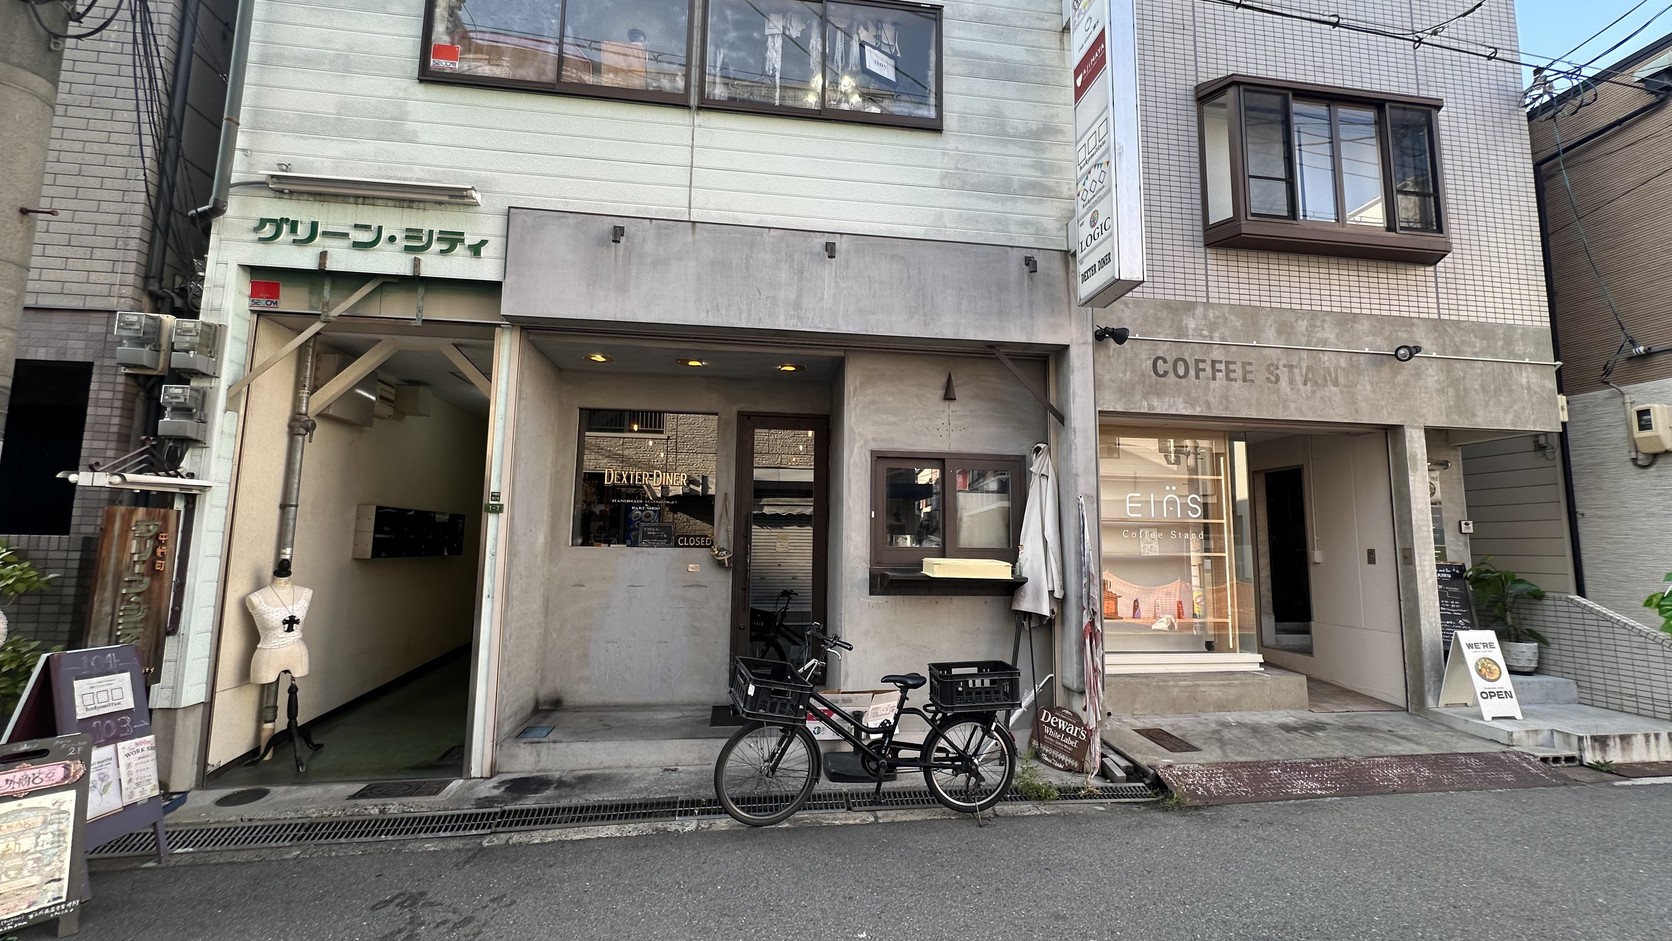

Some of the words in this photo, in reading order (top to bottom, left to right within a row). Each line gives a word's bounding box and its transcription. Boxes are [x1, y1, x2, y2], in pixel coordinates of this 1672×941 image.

[253, 216, 489, 257] グリーン・シティ
[1080, 217, 1111, 254] LOGIC
[1081, 263, 1097, 284] DEXTER
[1097, 252, 1112, 272] DINER
[1151, 355, 1255, 384] COFFEE
[653, 469, 688, 487] DINER
[677, 536, 712, 546] CLOSED
[1122, 529, 1163, 539] Coffee
[1170, 530, 1204, 539] Stand
[1466, 641, 1496, 650] WE'RE
[1480, 690, 1514, 700] OPEN
[91, 715, 134, 745] 103
